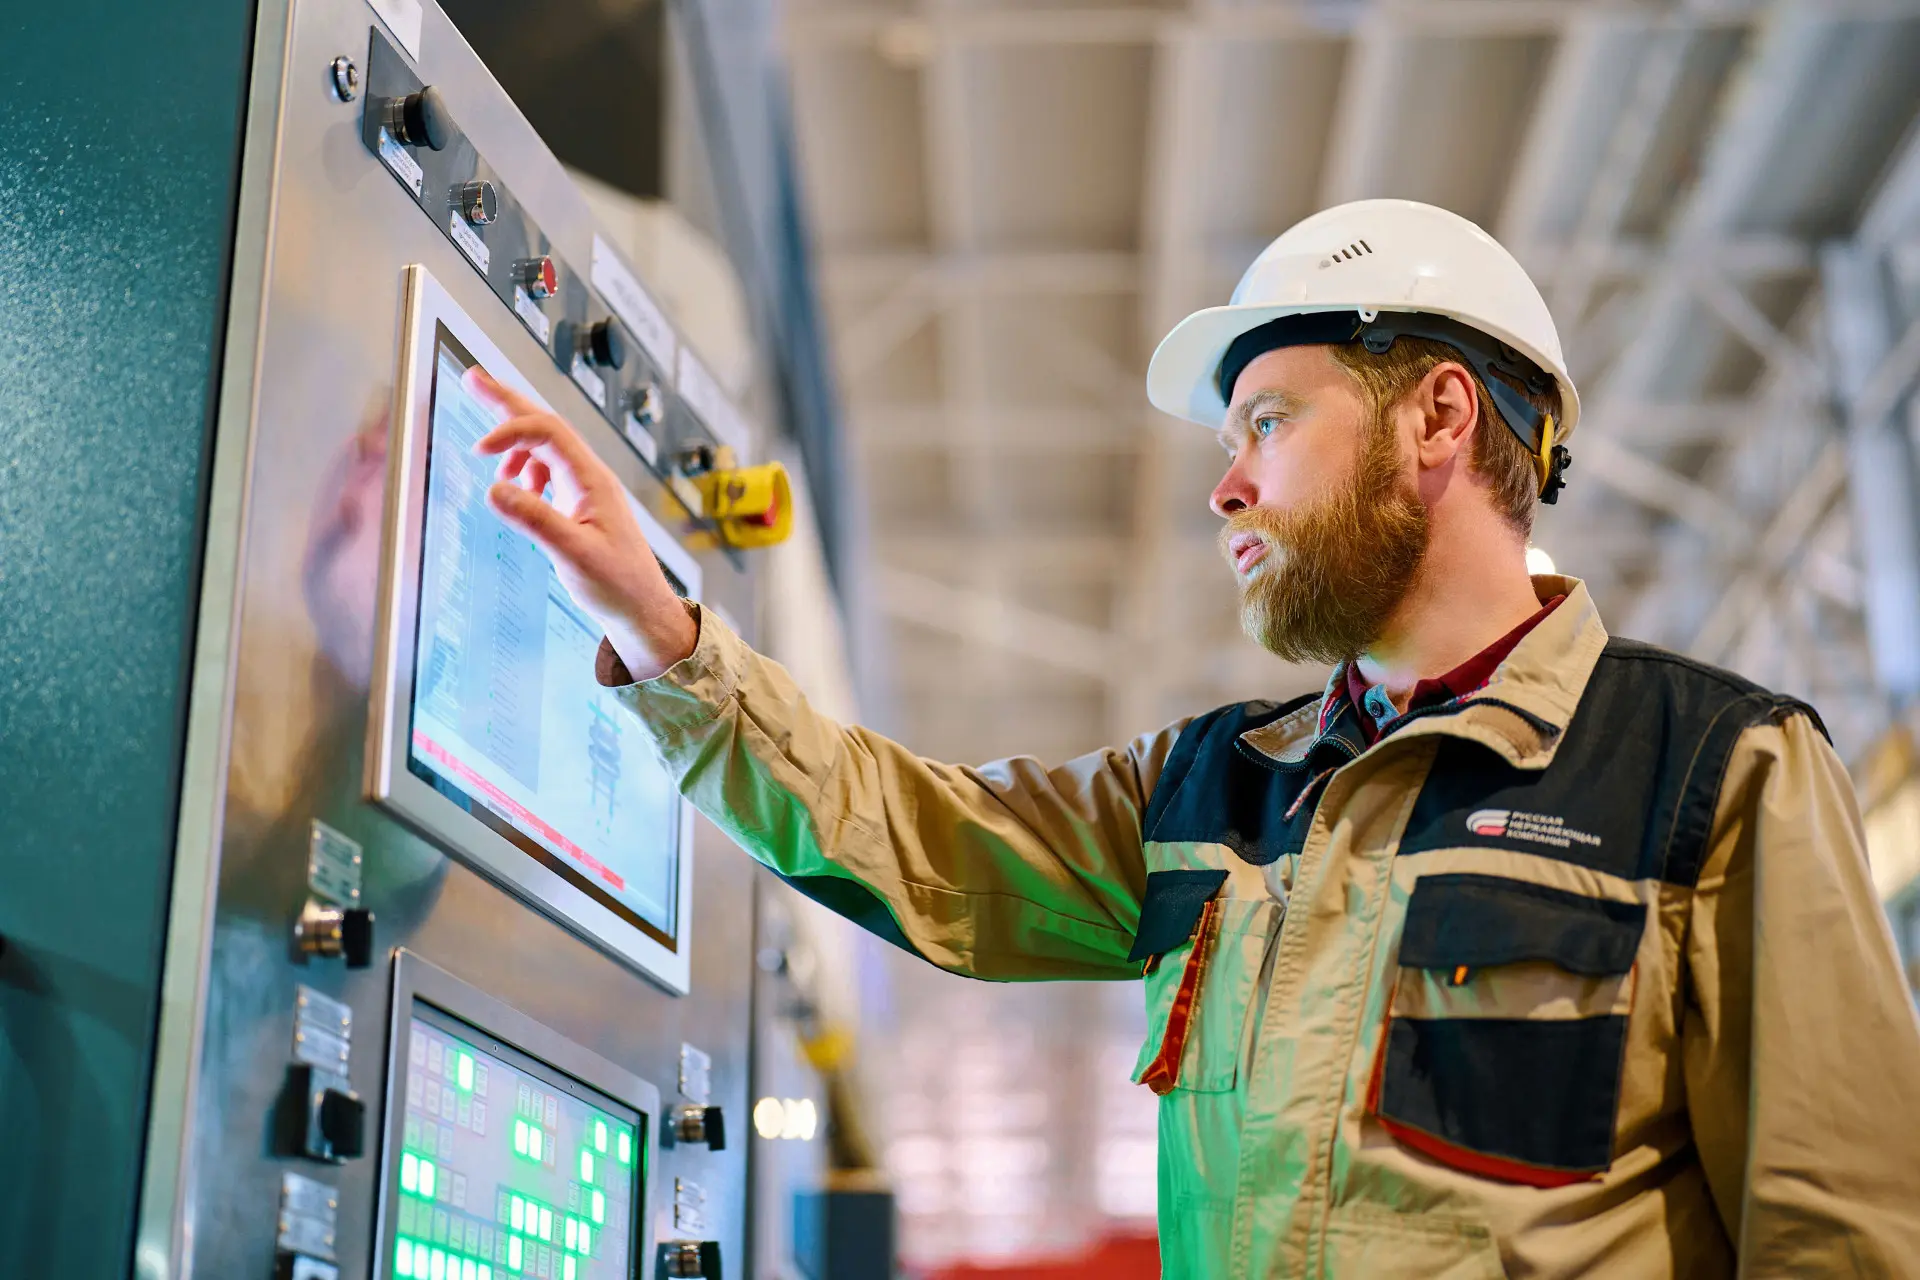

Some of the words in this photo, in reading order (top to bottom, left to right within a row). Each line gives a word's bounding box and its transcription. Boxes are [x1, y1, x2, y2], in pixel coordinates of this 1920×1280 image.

[1511, 811, 1564, 826] РУССКАЯ
[1506, 829, 1570, 848] КОМПАНИЯ
[1508, 820, 1601, 848] НЕРЖАВЕЮЩАЯ
